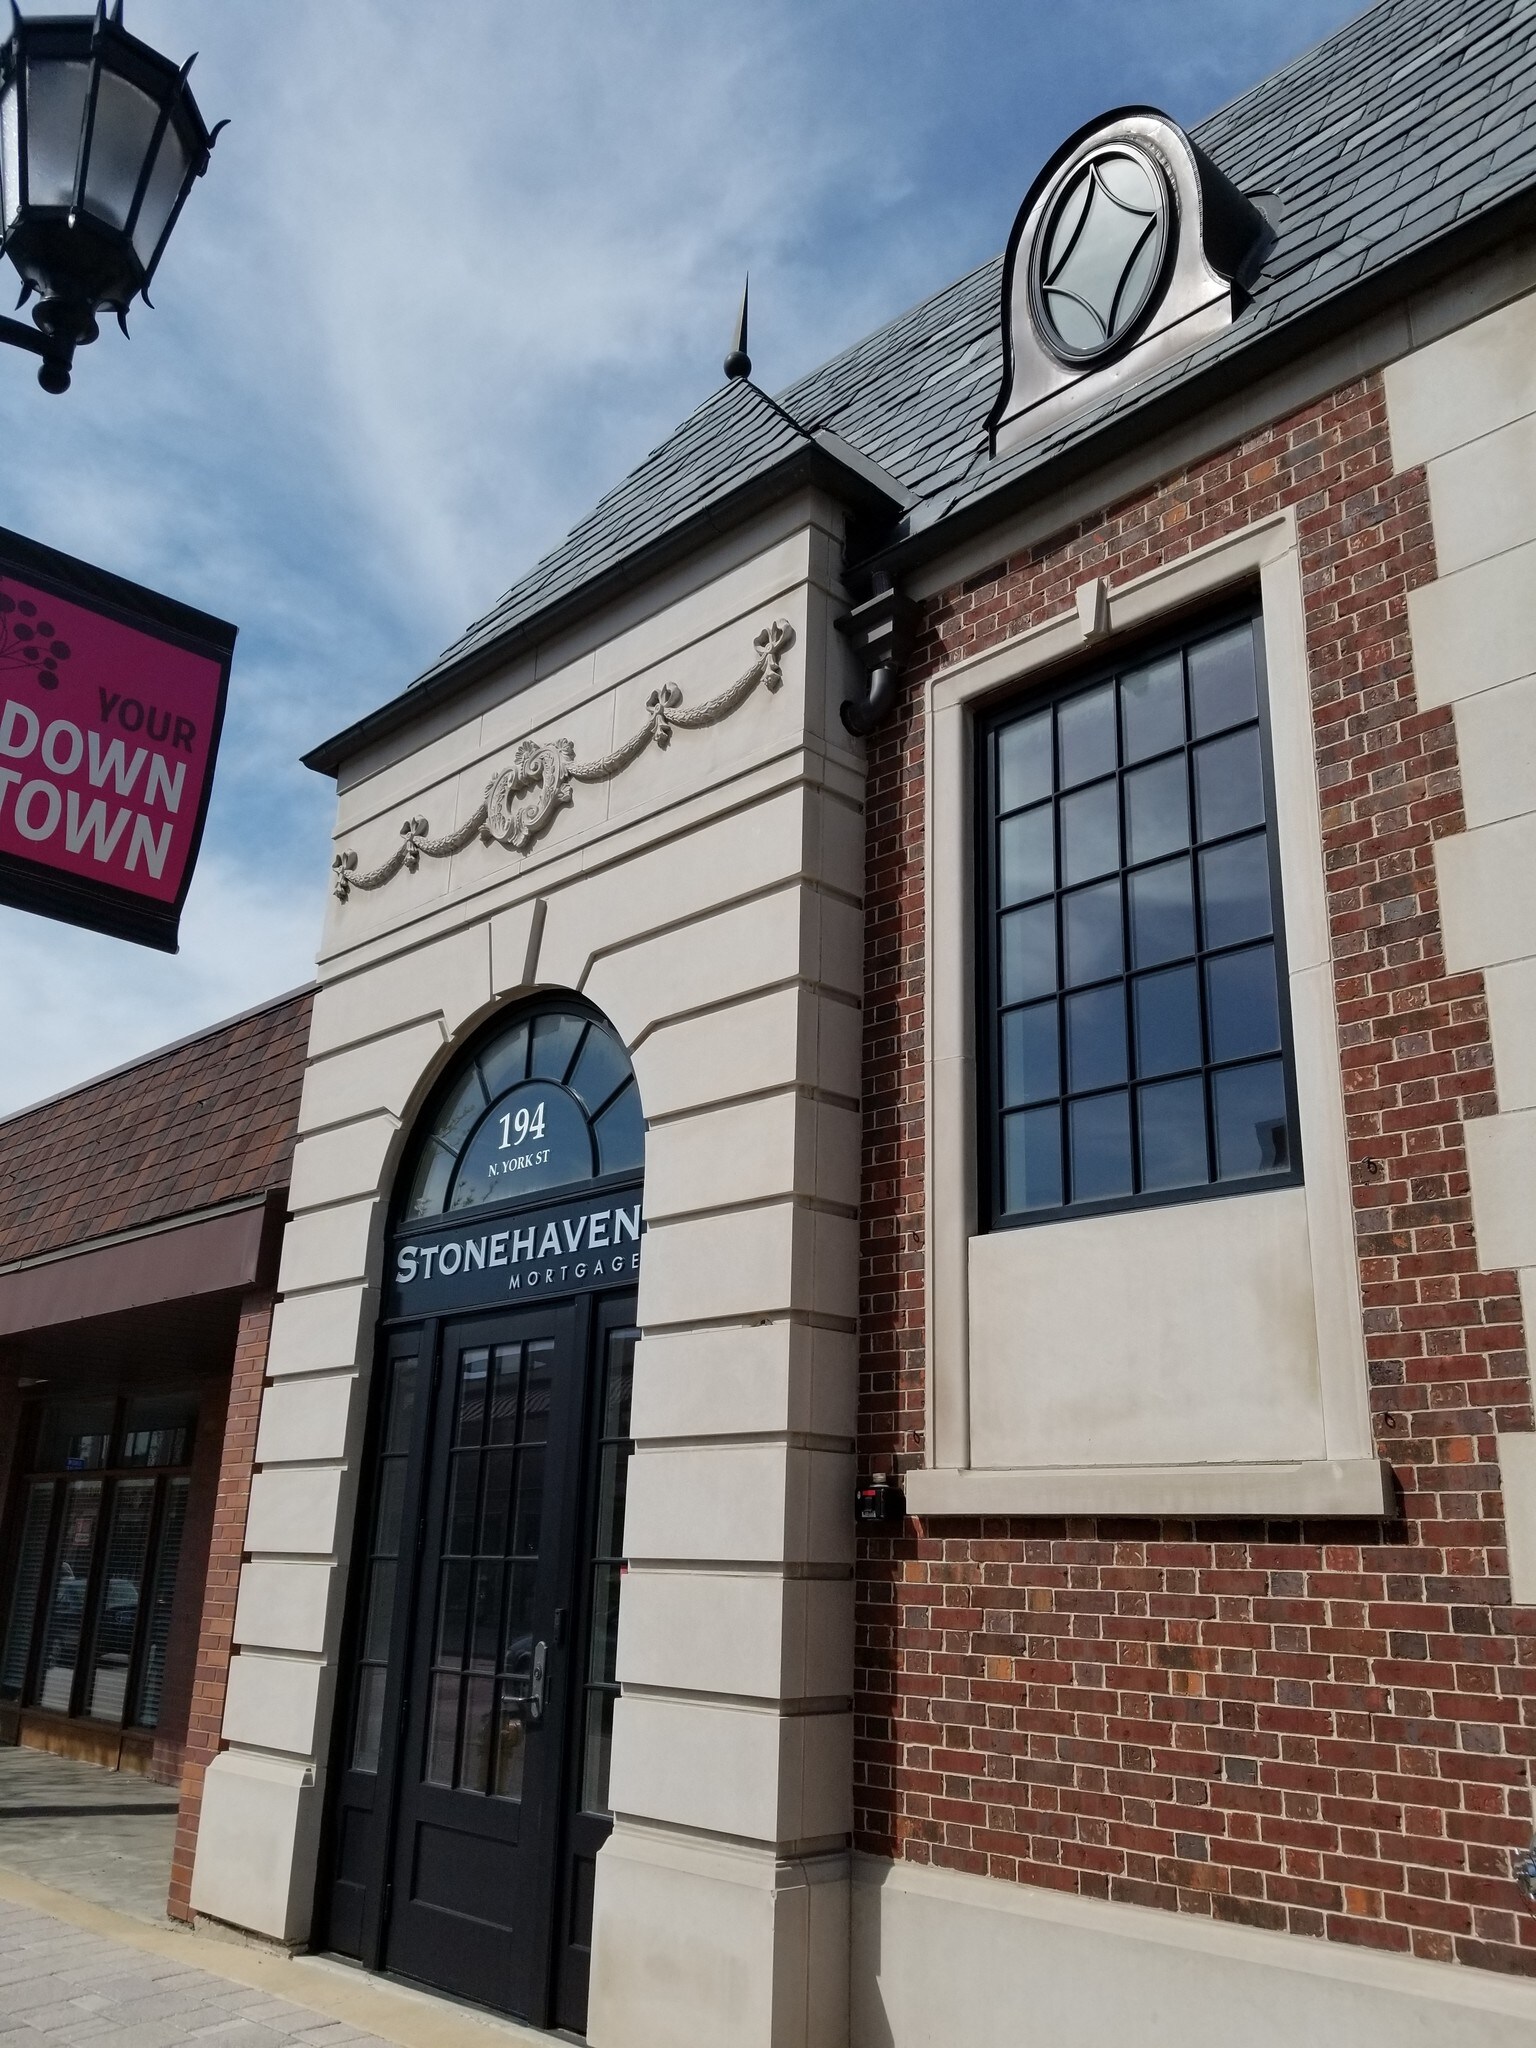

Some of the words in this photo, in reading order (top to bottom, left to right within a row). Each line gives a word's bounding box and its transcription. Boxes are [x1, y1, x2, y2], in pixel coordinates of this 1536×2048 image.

[98, 686, 197, 754] YOUR
[0, 699, 187, 814] DOWN
[498, 1101, 546, 1150] 194
[487, 1163, 500, 1178] N.
[502, 1153, 533, 1174] YORK
[535, 1149, 551, 1165] ST
[395, 1204, 642, 1283] STONEHAVEN
[508, 1253, 640, 1290] MORTGAGE
